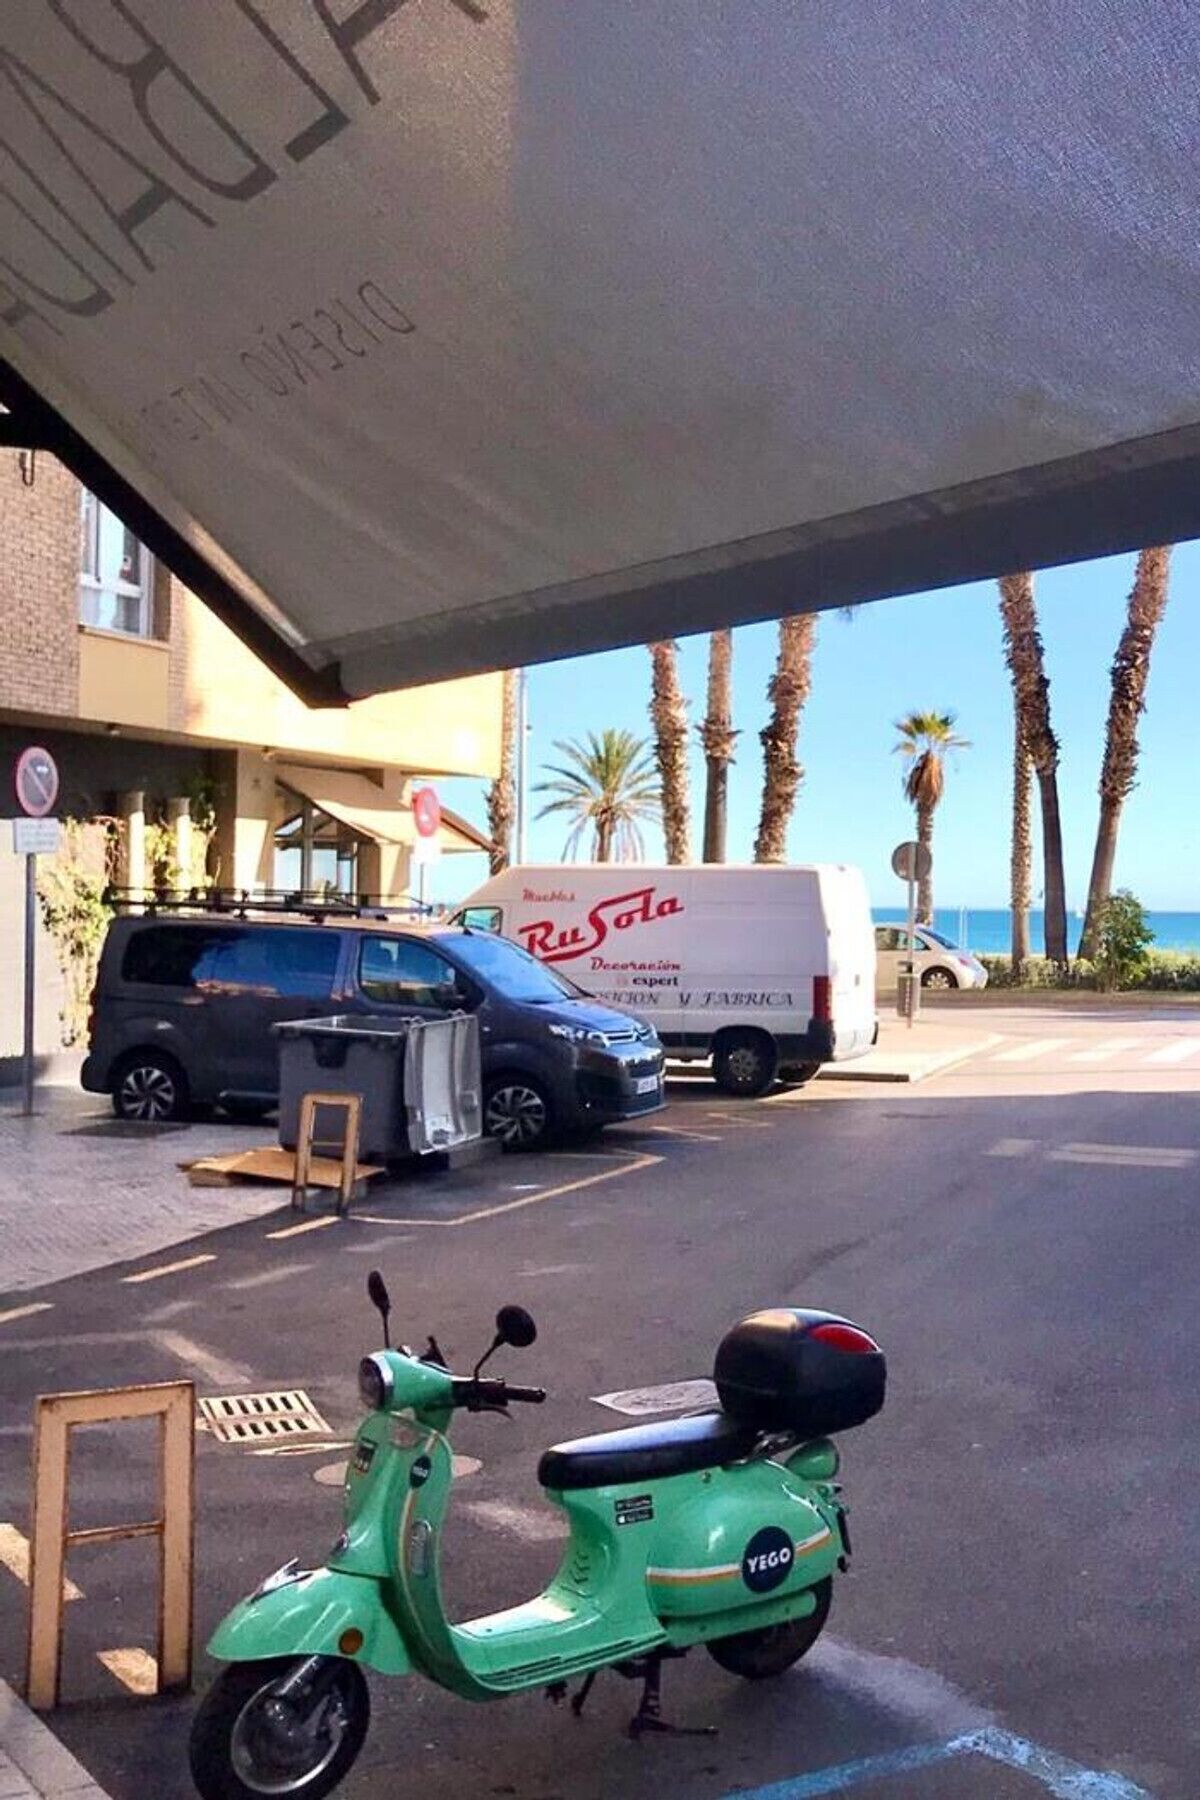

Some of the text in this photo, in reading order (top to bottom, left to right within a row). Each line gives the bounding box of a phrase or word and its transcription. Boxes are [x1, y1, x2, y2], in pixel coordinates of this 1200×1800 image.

[632, 976, 679, 988] expert
[600, 990, 659, 1005] SICION
[700, 991, 793, 1008] FABRICA
[746, 1547, 792, 1574] YEGO
